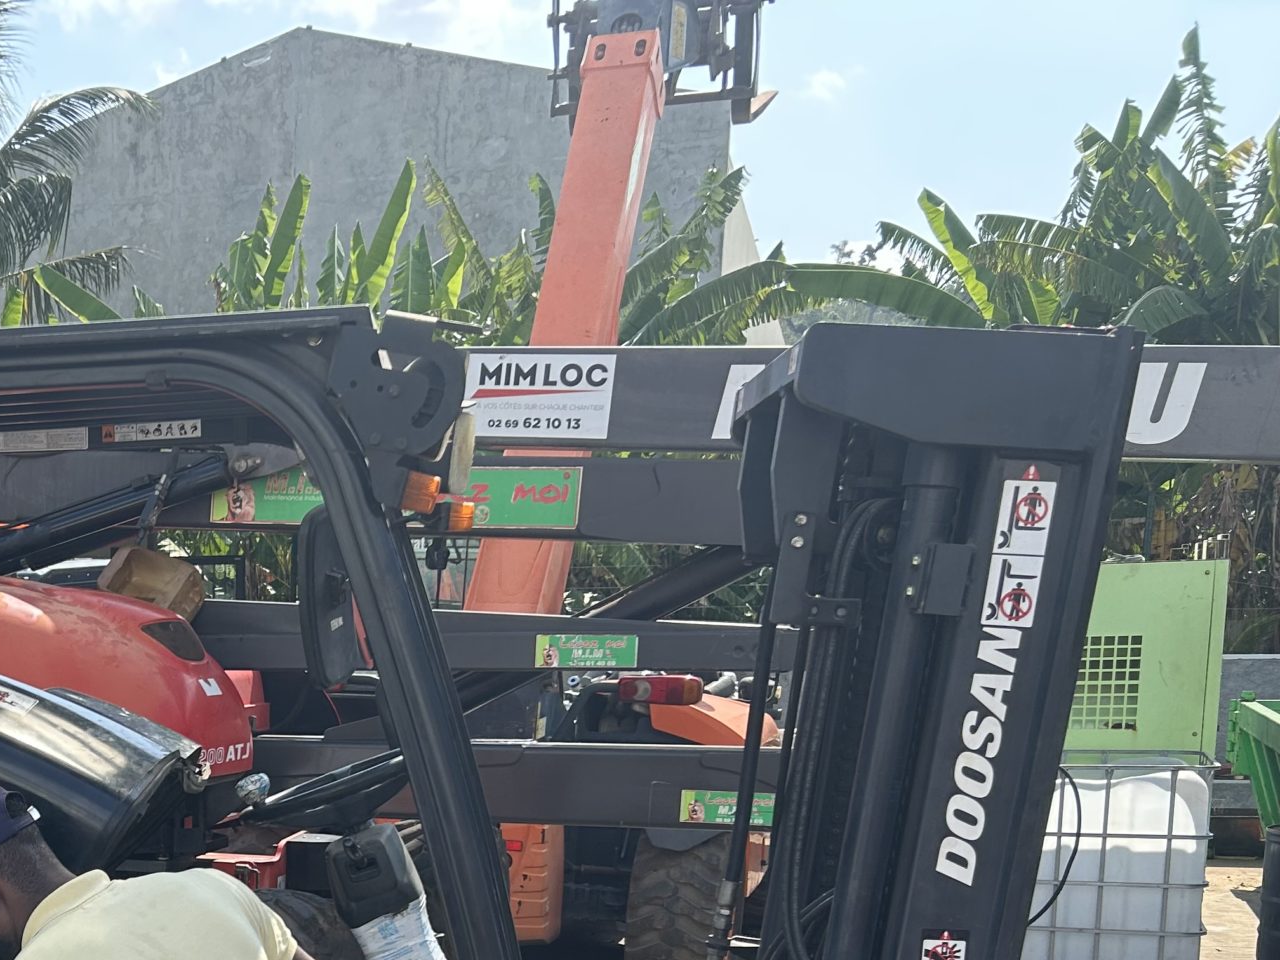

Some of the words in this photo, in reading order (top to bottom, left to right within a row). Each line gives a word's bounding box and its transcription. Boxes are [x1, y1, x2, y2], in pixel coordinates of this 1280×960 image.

[488, 419, 501, 428] 02
[505, 419, 519, 428] 69
[523, 417, 540, 429] 62
[546, 417, 561, 429] 10
[567, 418, 581, 430] 13
[226, 742, 251, 762] ATJ
[935, 626, 1023, 887] DOOSAN
